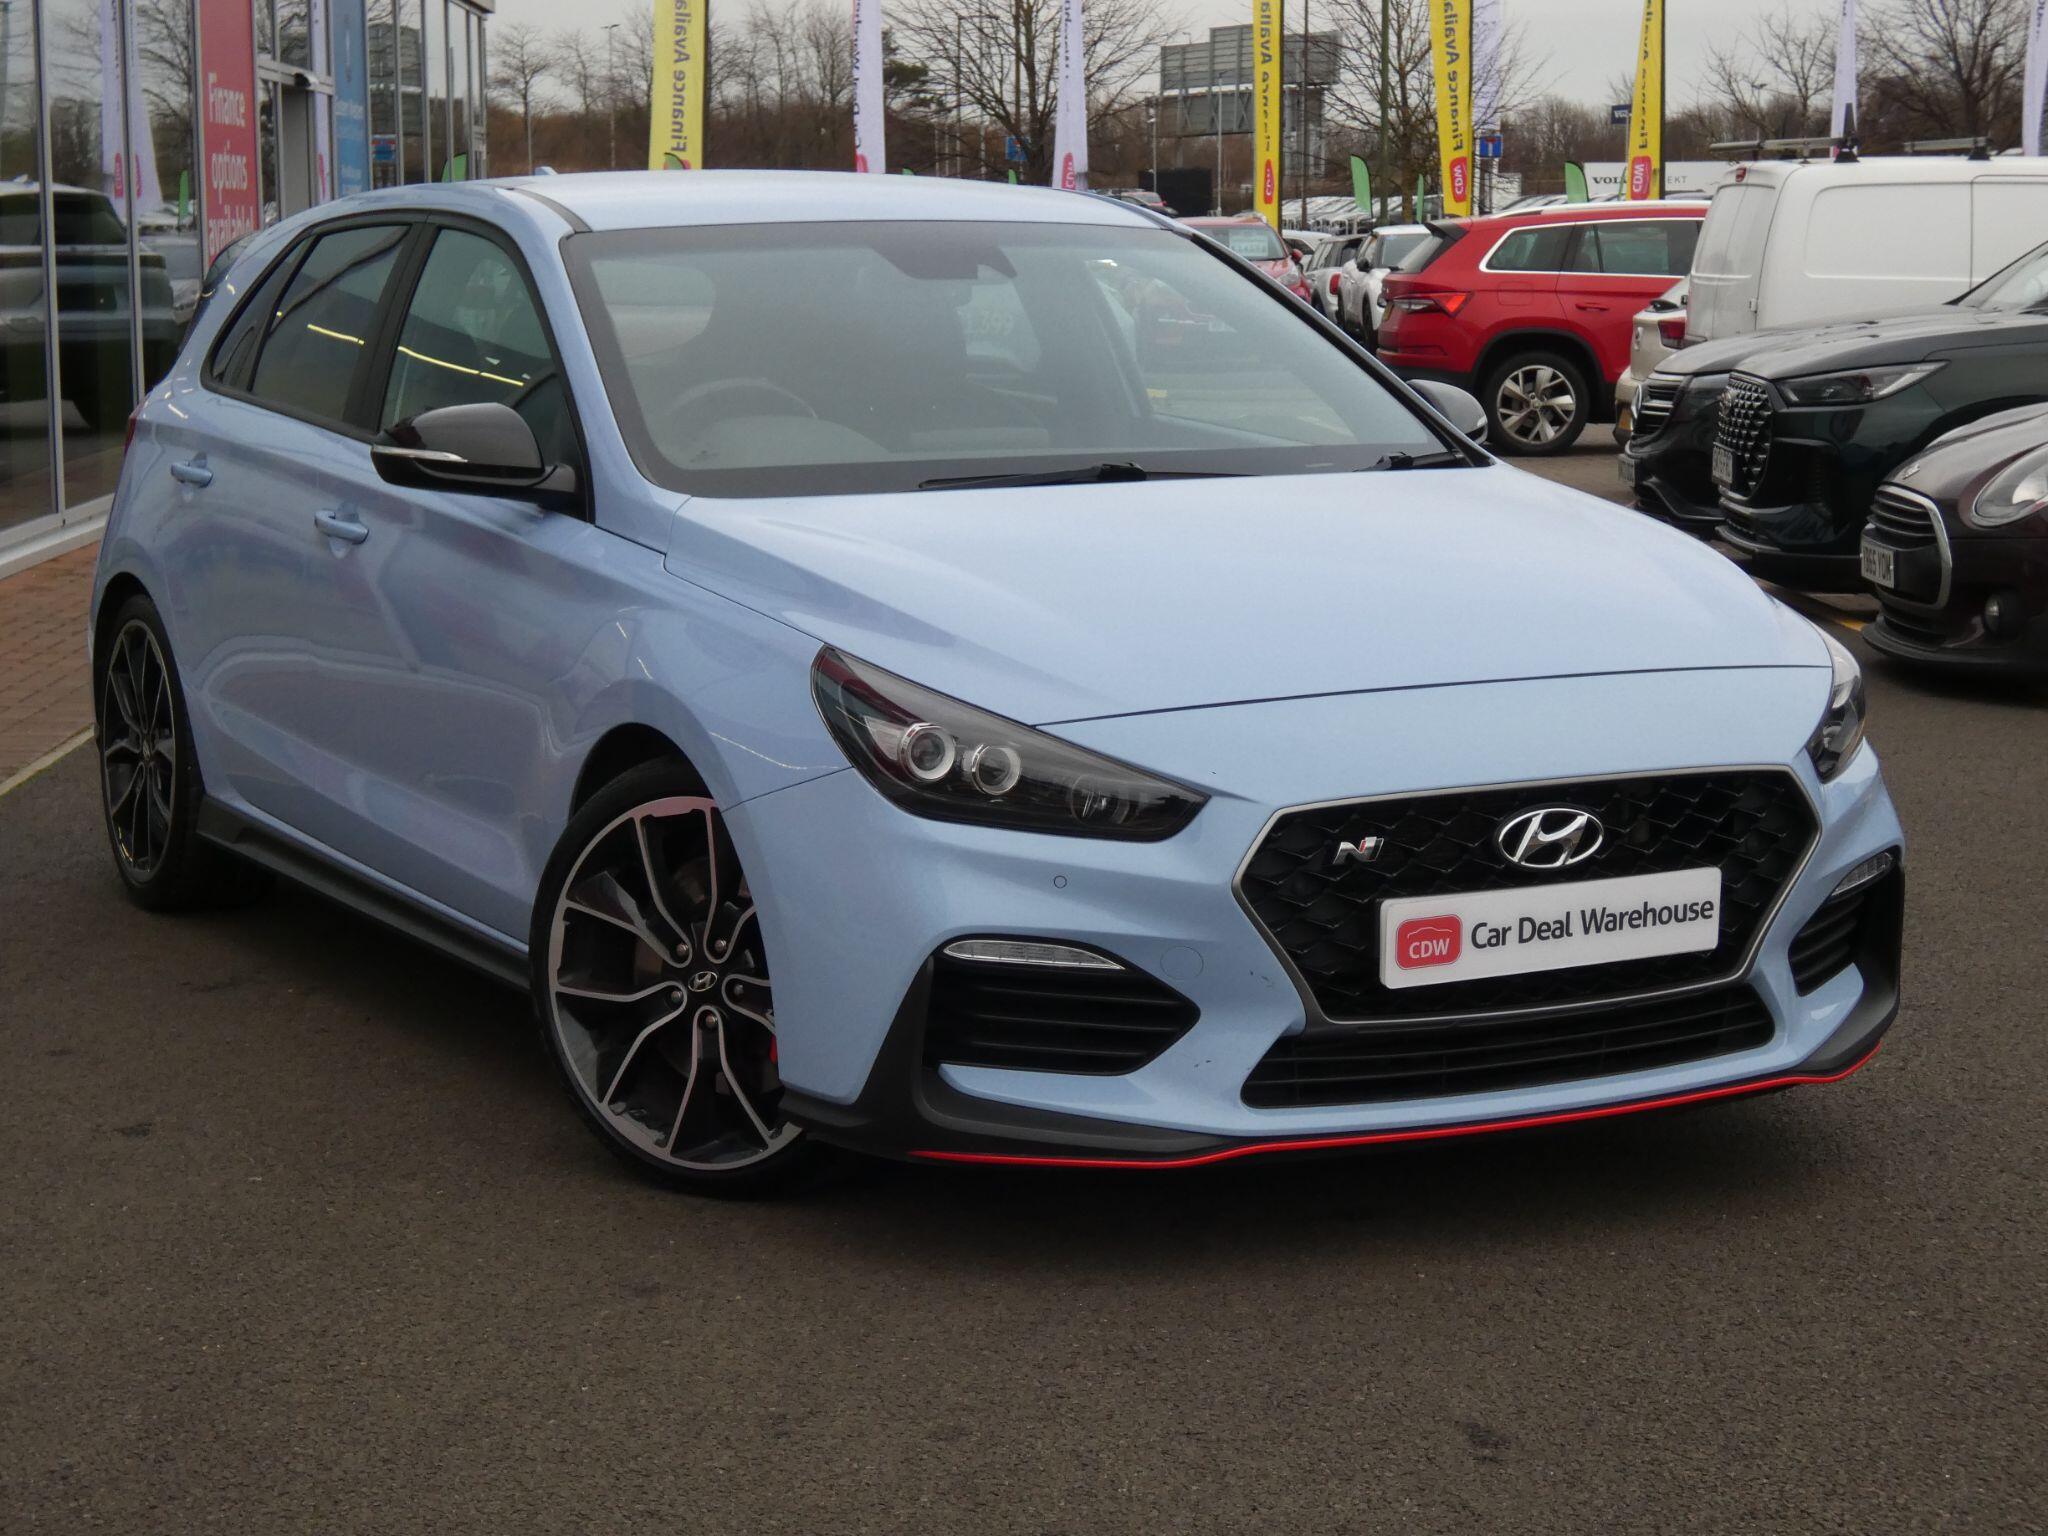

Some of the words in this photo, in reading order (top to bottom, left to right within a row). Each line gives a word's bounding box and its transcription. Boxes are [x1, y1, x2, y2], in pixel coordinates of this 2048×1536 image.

[208, 72, 246, 128] Finance
[211, 140, 248, 204] options
[1408, 938, 1450, 959] CDW
[1471, 922, 1511, 949] Car
[1518, 911, 1573, 945] Deal
[1580, 900, 1714, 936] Warehouse
